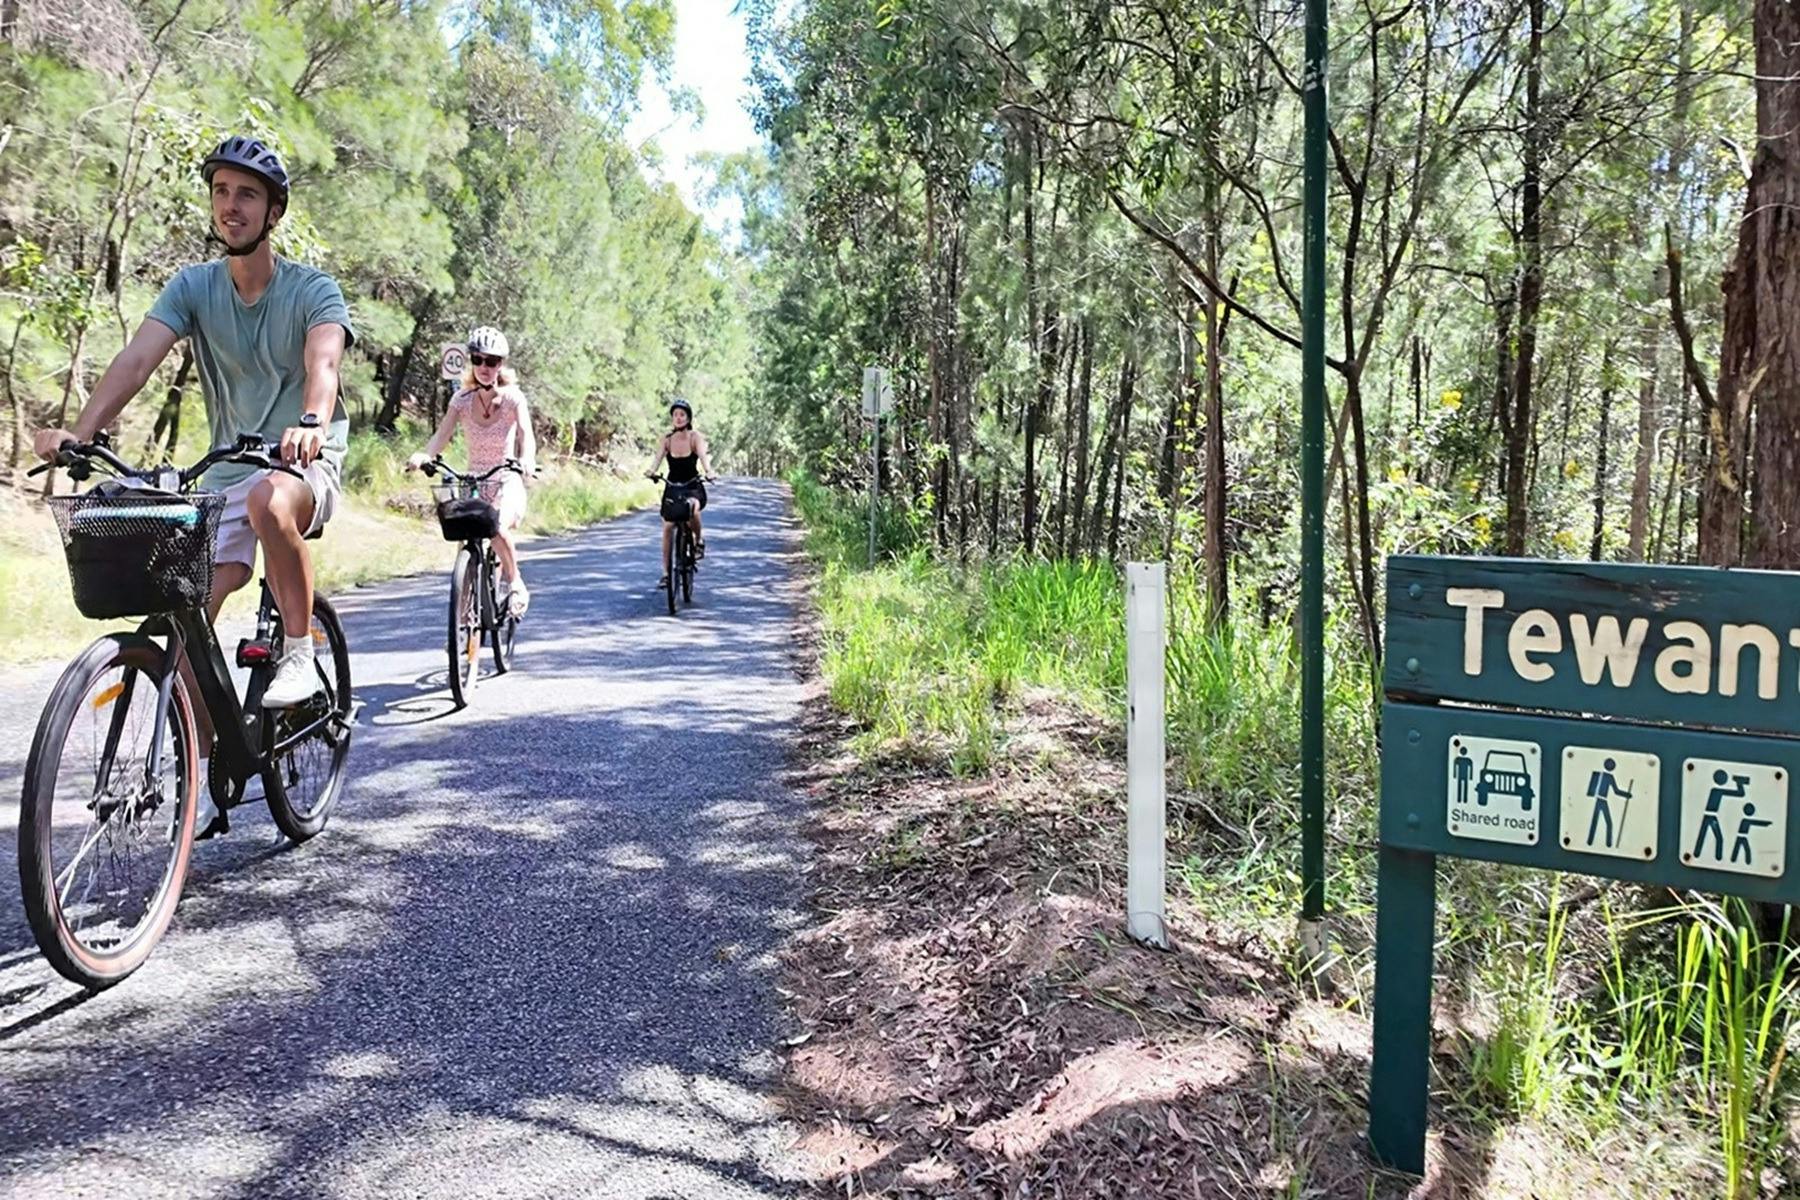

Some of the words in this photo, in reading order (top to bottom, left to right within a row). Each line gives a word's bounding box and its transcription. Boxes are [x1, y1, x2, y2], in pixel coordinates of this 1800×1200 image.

[447, 355, 463, 368] 40
[1451, 808, 1500, 826] Shared
[1504, 817, 1535, 830] road
